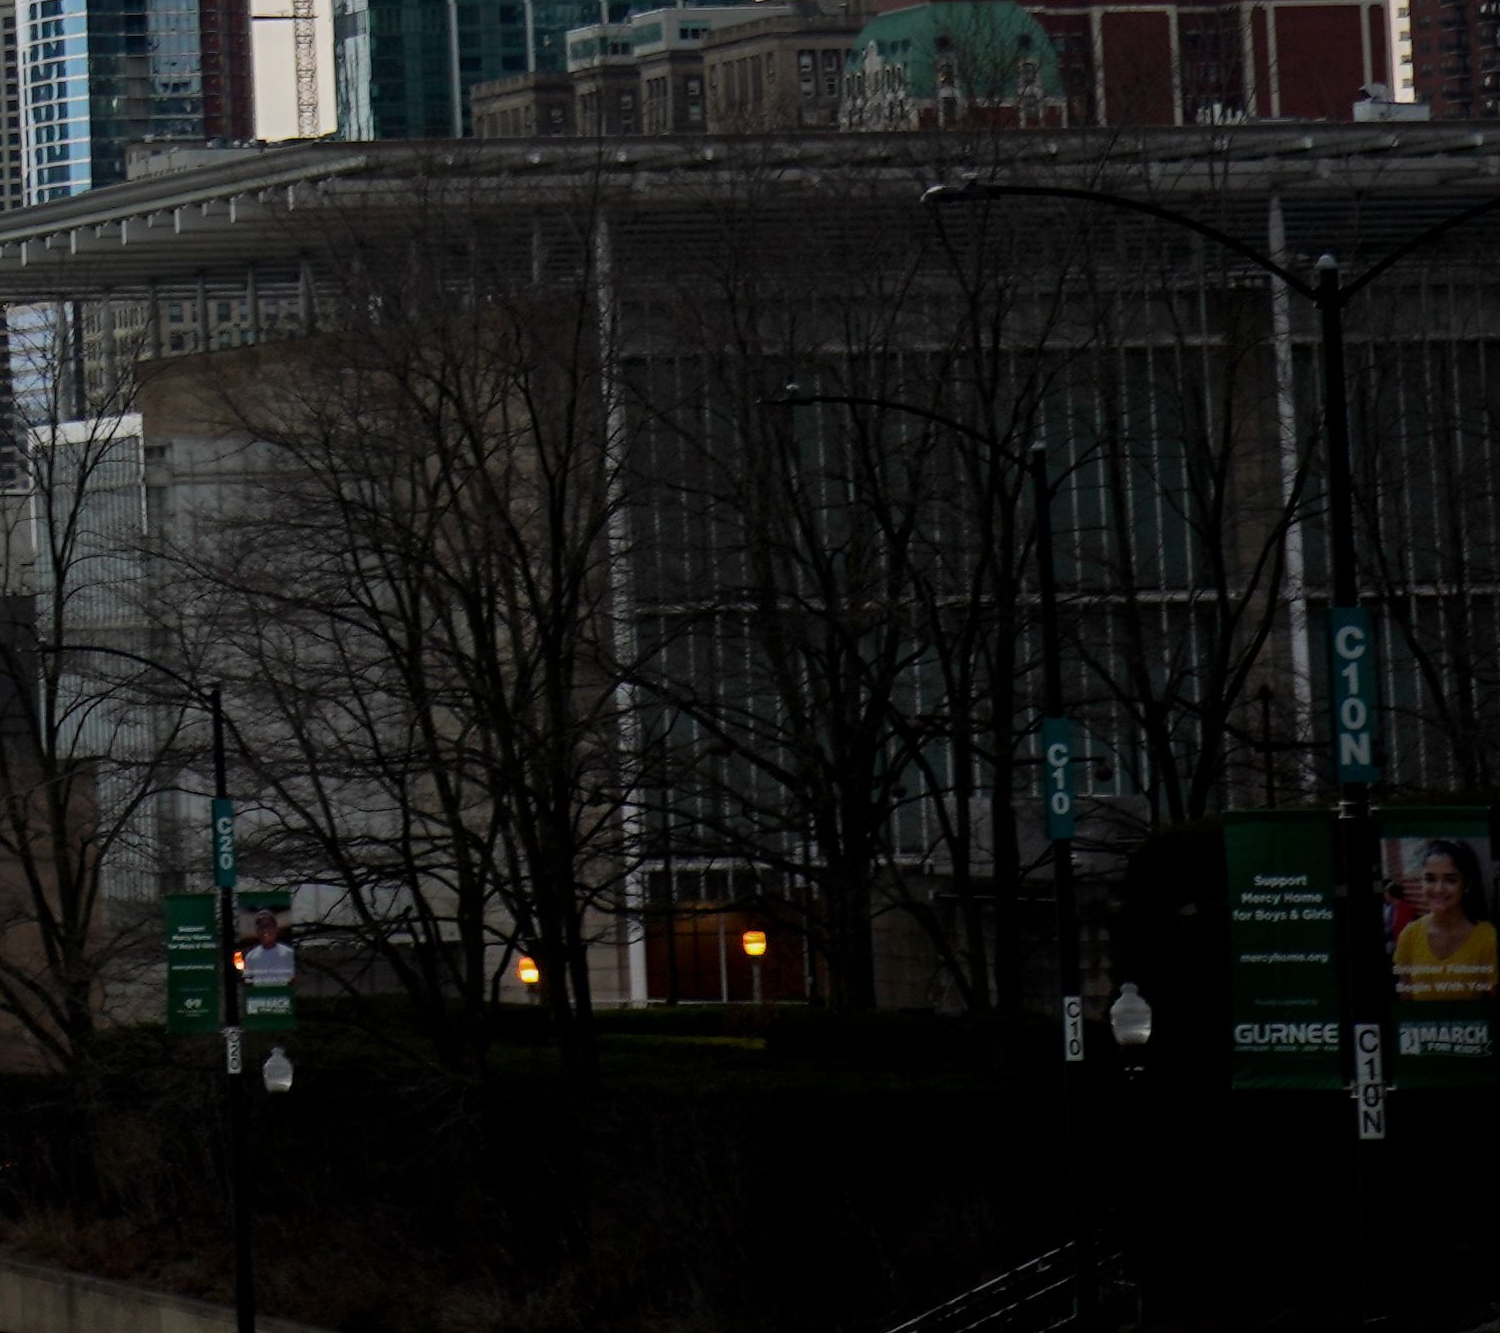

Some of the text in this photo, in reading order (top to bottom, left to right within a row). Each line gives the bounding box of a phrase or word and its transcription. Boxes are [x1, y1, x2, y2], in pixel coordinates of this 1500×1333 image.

[1334, 625, 1371, 766] C10N
[1046, 743, 1071, 815] C10
[216, 816, 234, 870] C20
[1240, 892, 1324, 905] Mercy Home
[1253, 874, 1308, 888] Support
[1232, 908, 1334, 922] for Boys & Girls
[1067, 1002, 1080, 1056] C10
[1234, 1023, 1341, 1044] GURNEE
[1359, 1029, 1382, 1133] C10N
